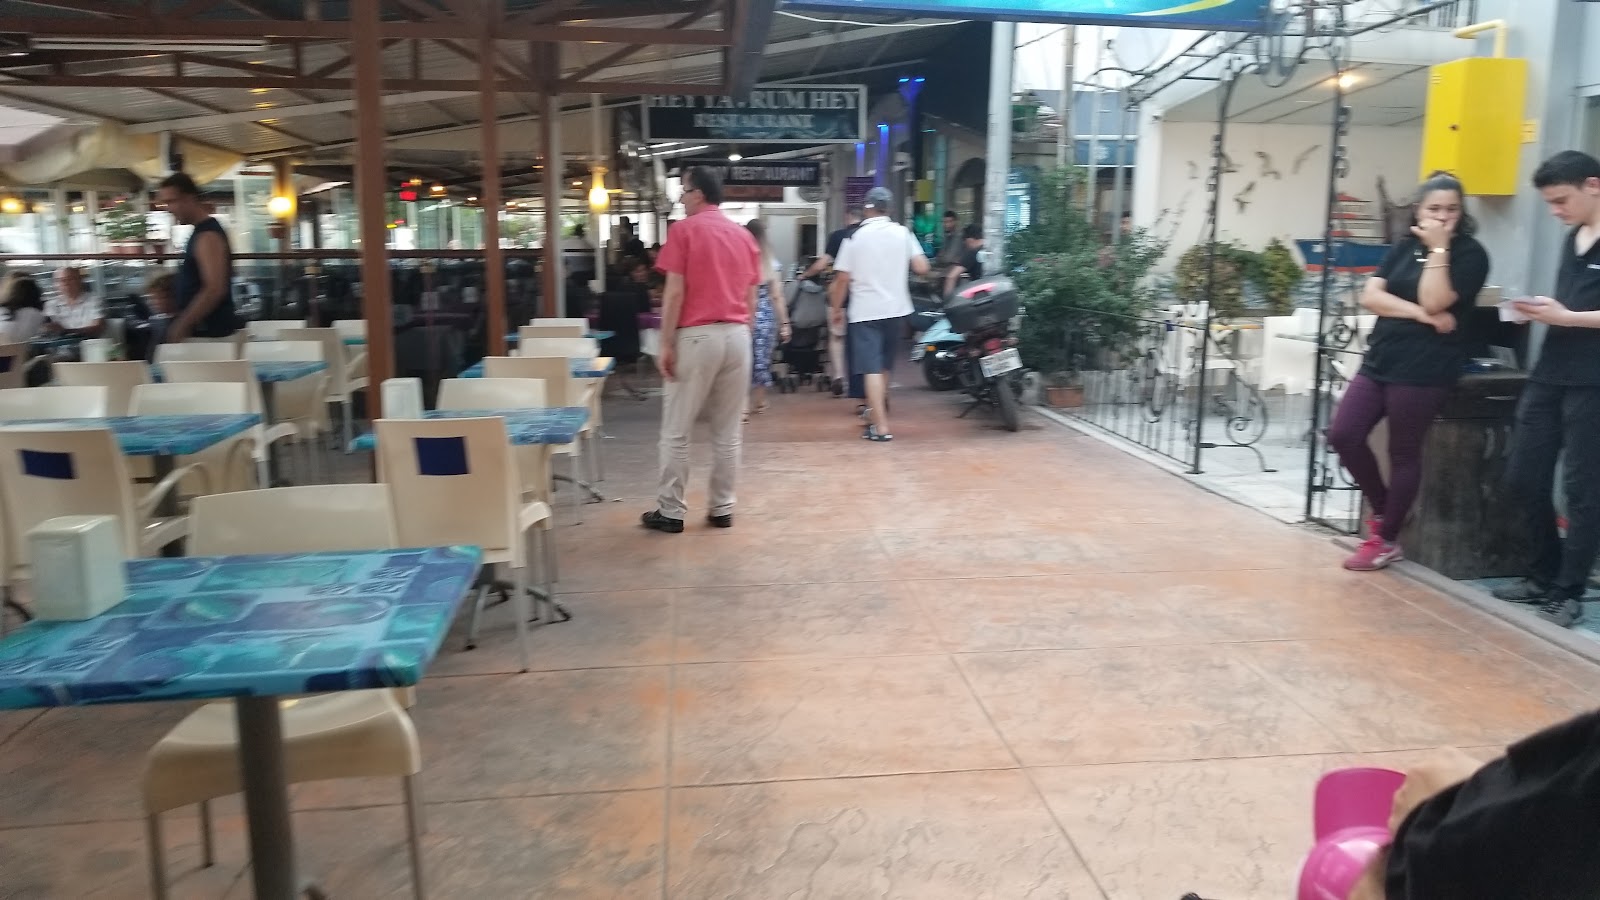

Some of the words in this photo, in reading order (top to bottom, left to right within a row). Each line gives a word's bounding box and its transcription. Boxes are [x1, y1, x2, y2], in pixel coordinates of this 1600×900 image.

[648, 94, 696, 108] HEY
[704, 91, 807, 109] YARUM
[809, 91, 859, 109] HEY
[693, 114, 815, 128] RESTAURANT
